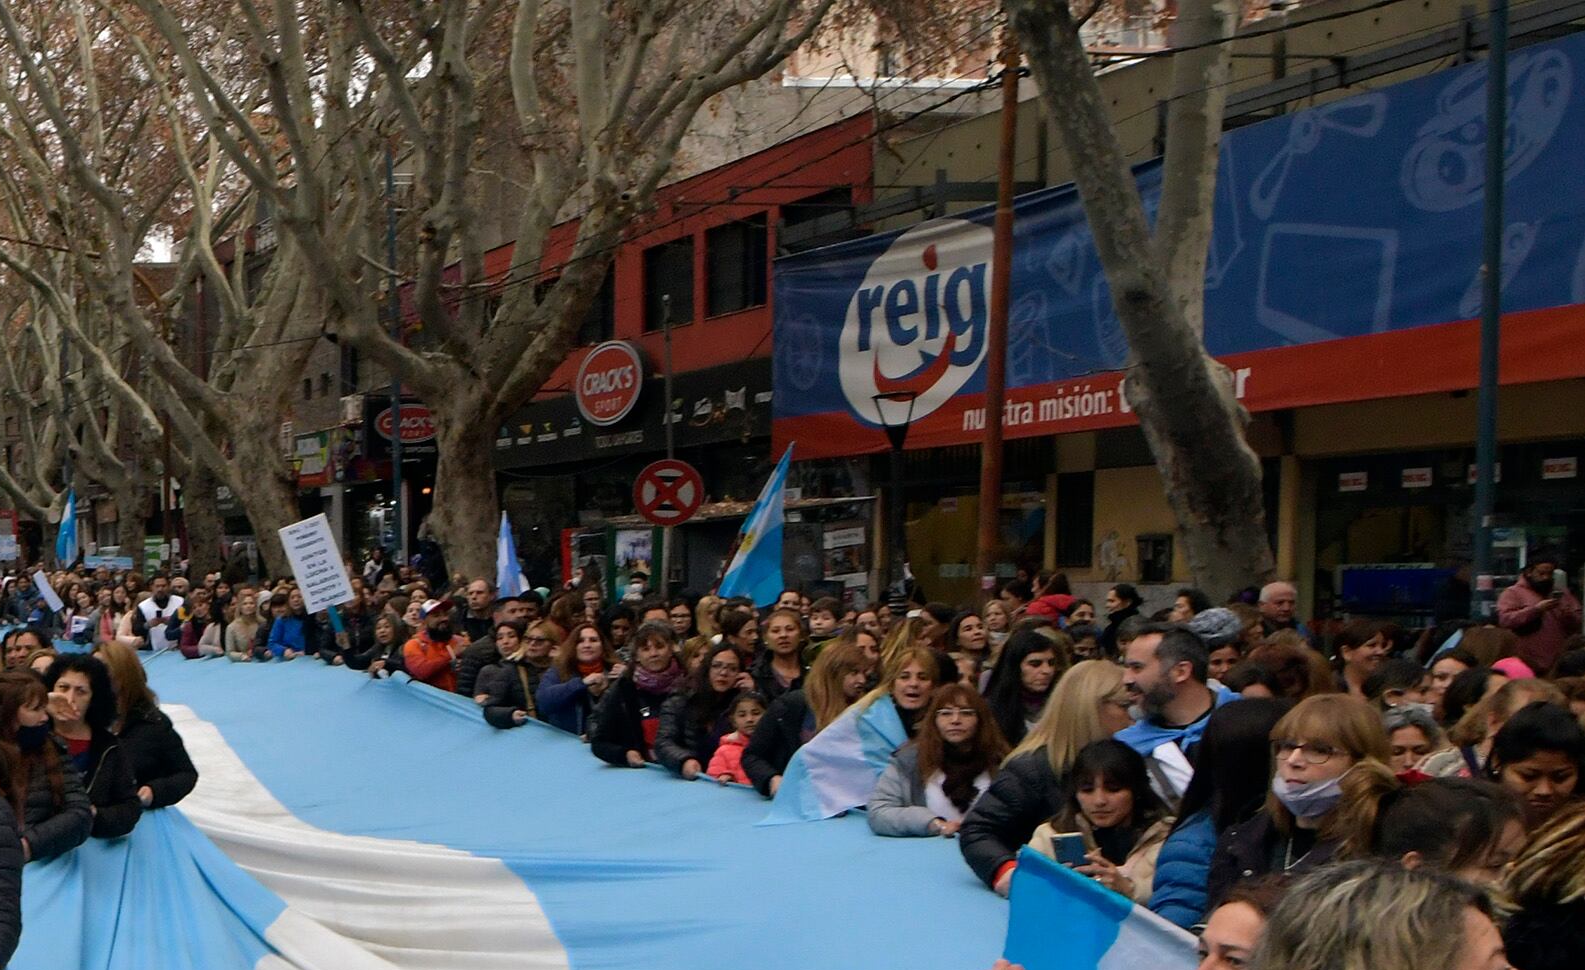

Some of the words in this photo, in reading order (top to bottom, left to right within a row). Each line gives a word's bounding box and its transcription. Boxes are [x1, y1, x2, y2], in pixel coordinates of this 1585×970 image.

[857, 244, 987, 368] reig
[582, 364, 635, 397] CRACK'S
[594, 397, 623, 414] SPORT
[963, 401, 1033, 432] nutra
[1039, 383, 1114, 422] misión:
